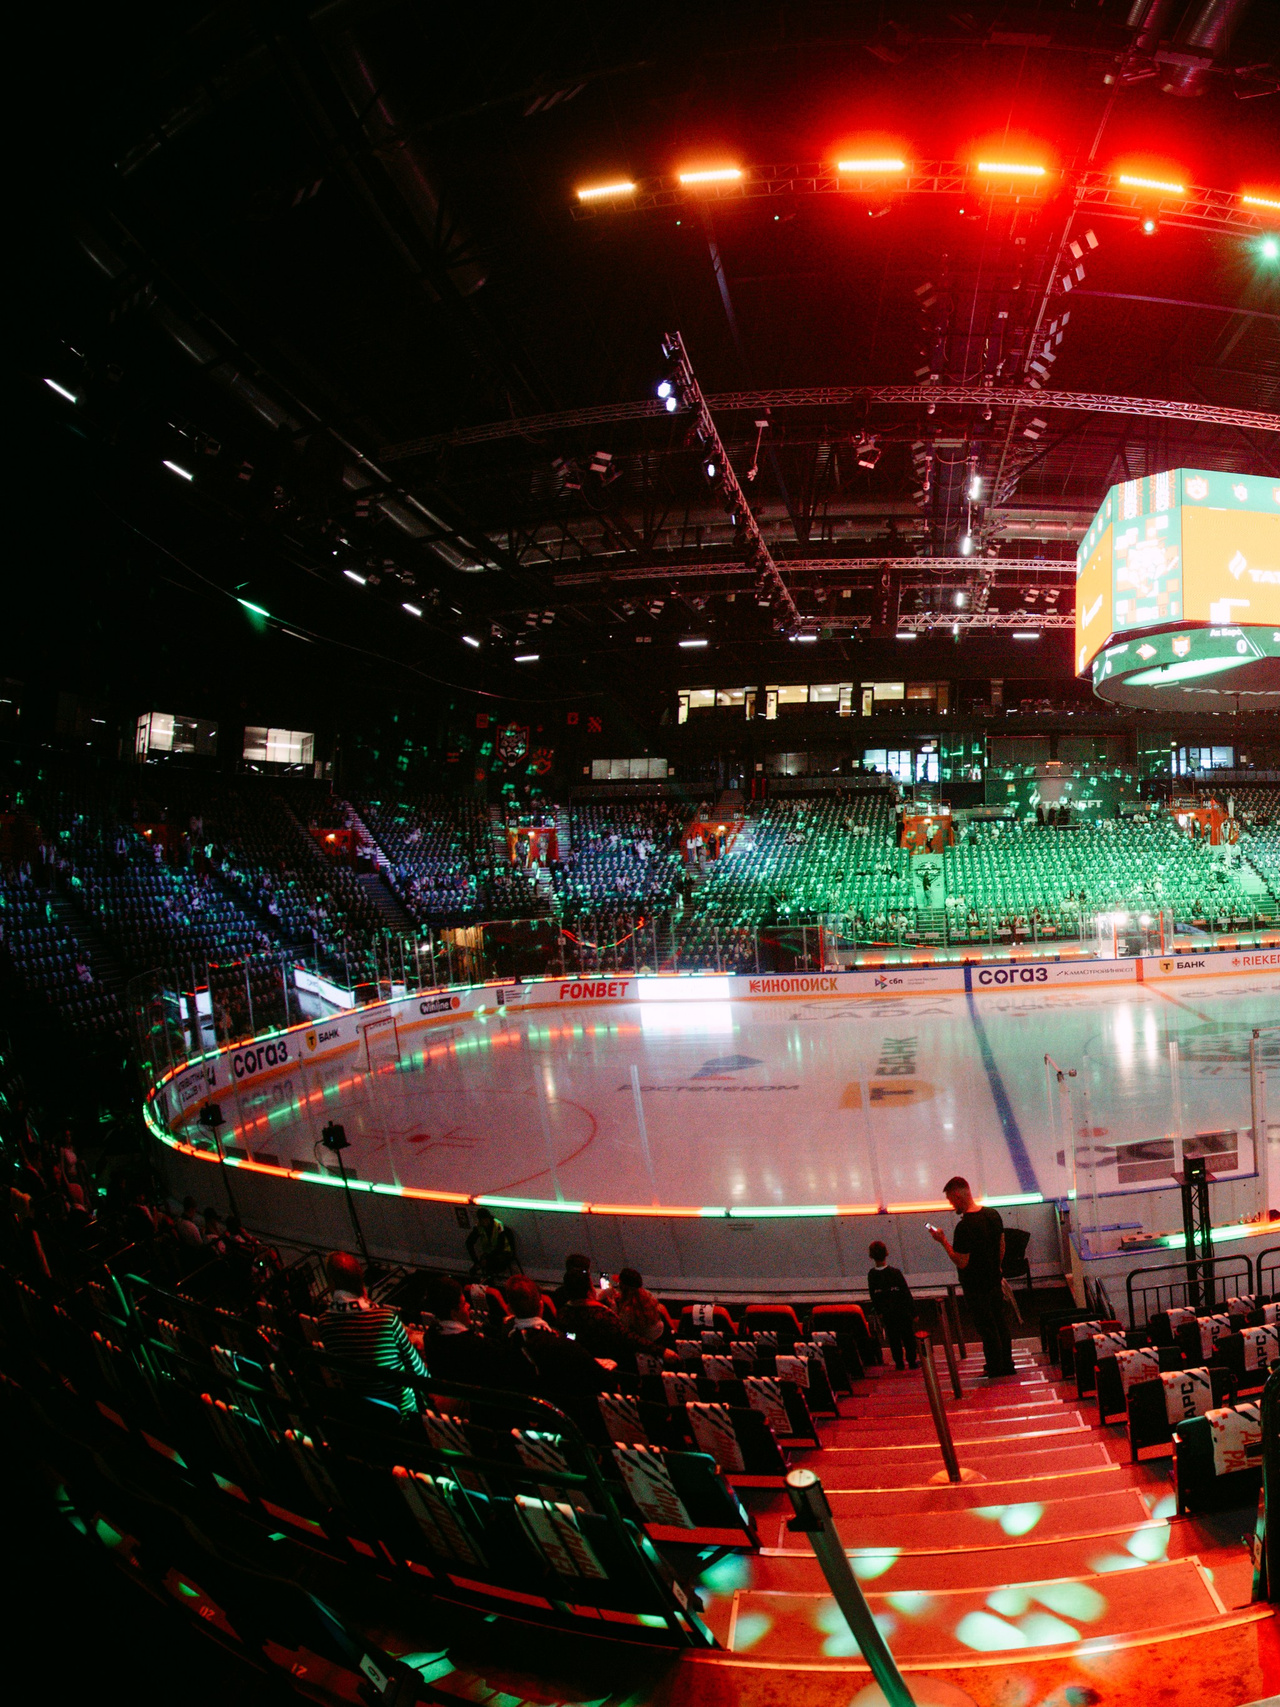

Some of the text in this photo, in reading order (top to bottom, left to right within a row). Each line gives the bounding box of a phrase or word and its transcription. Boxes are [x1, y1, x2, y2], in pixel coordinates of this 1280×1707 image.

[1043, 799, 1103, 810] TANEFT
[1177, 960, 1205, 969] БАНК
[559, 981, 629, 1000] FONBET
[749, 977, 838, 993] КИНОПОИСК
[789, 1008, 954, 1021] LADA
[318, 1028, 340, 1043] БАНК
